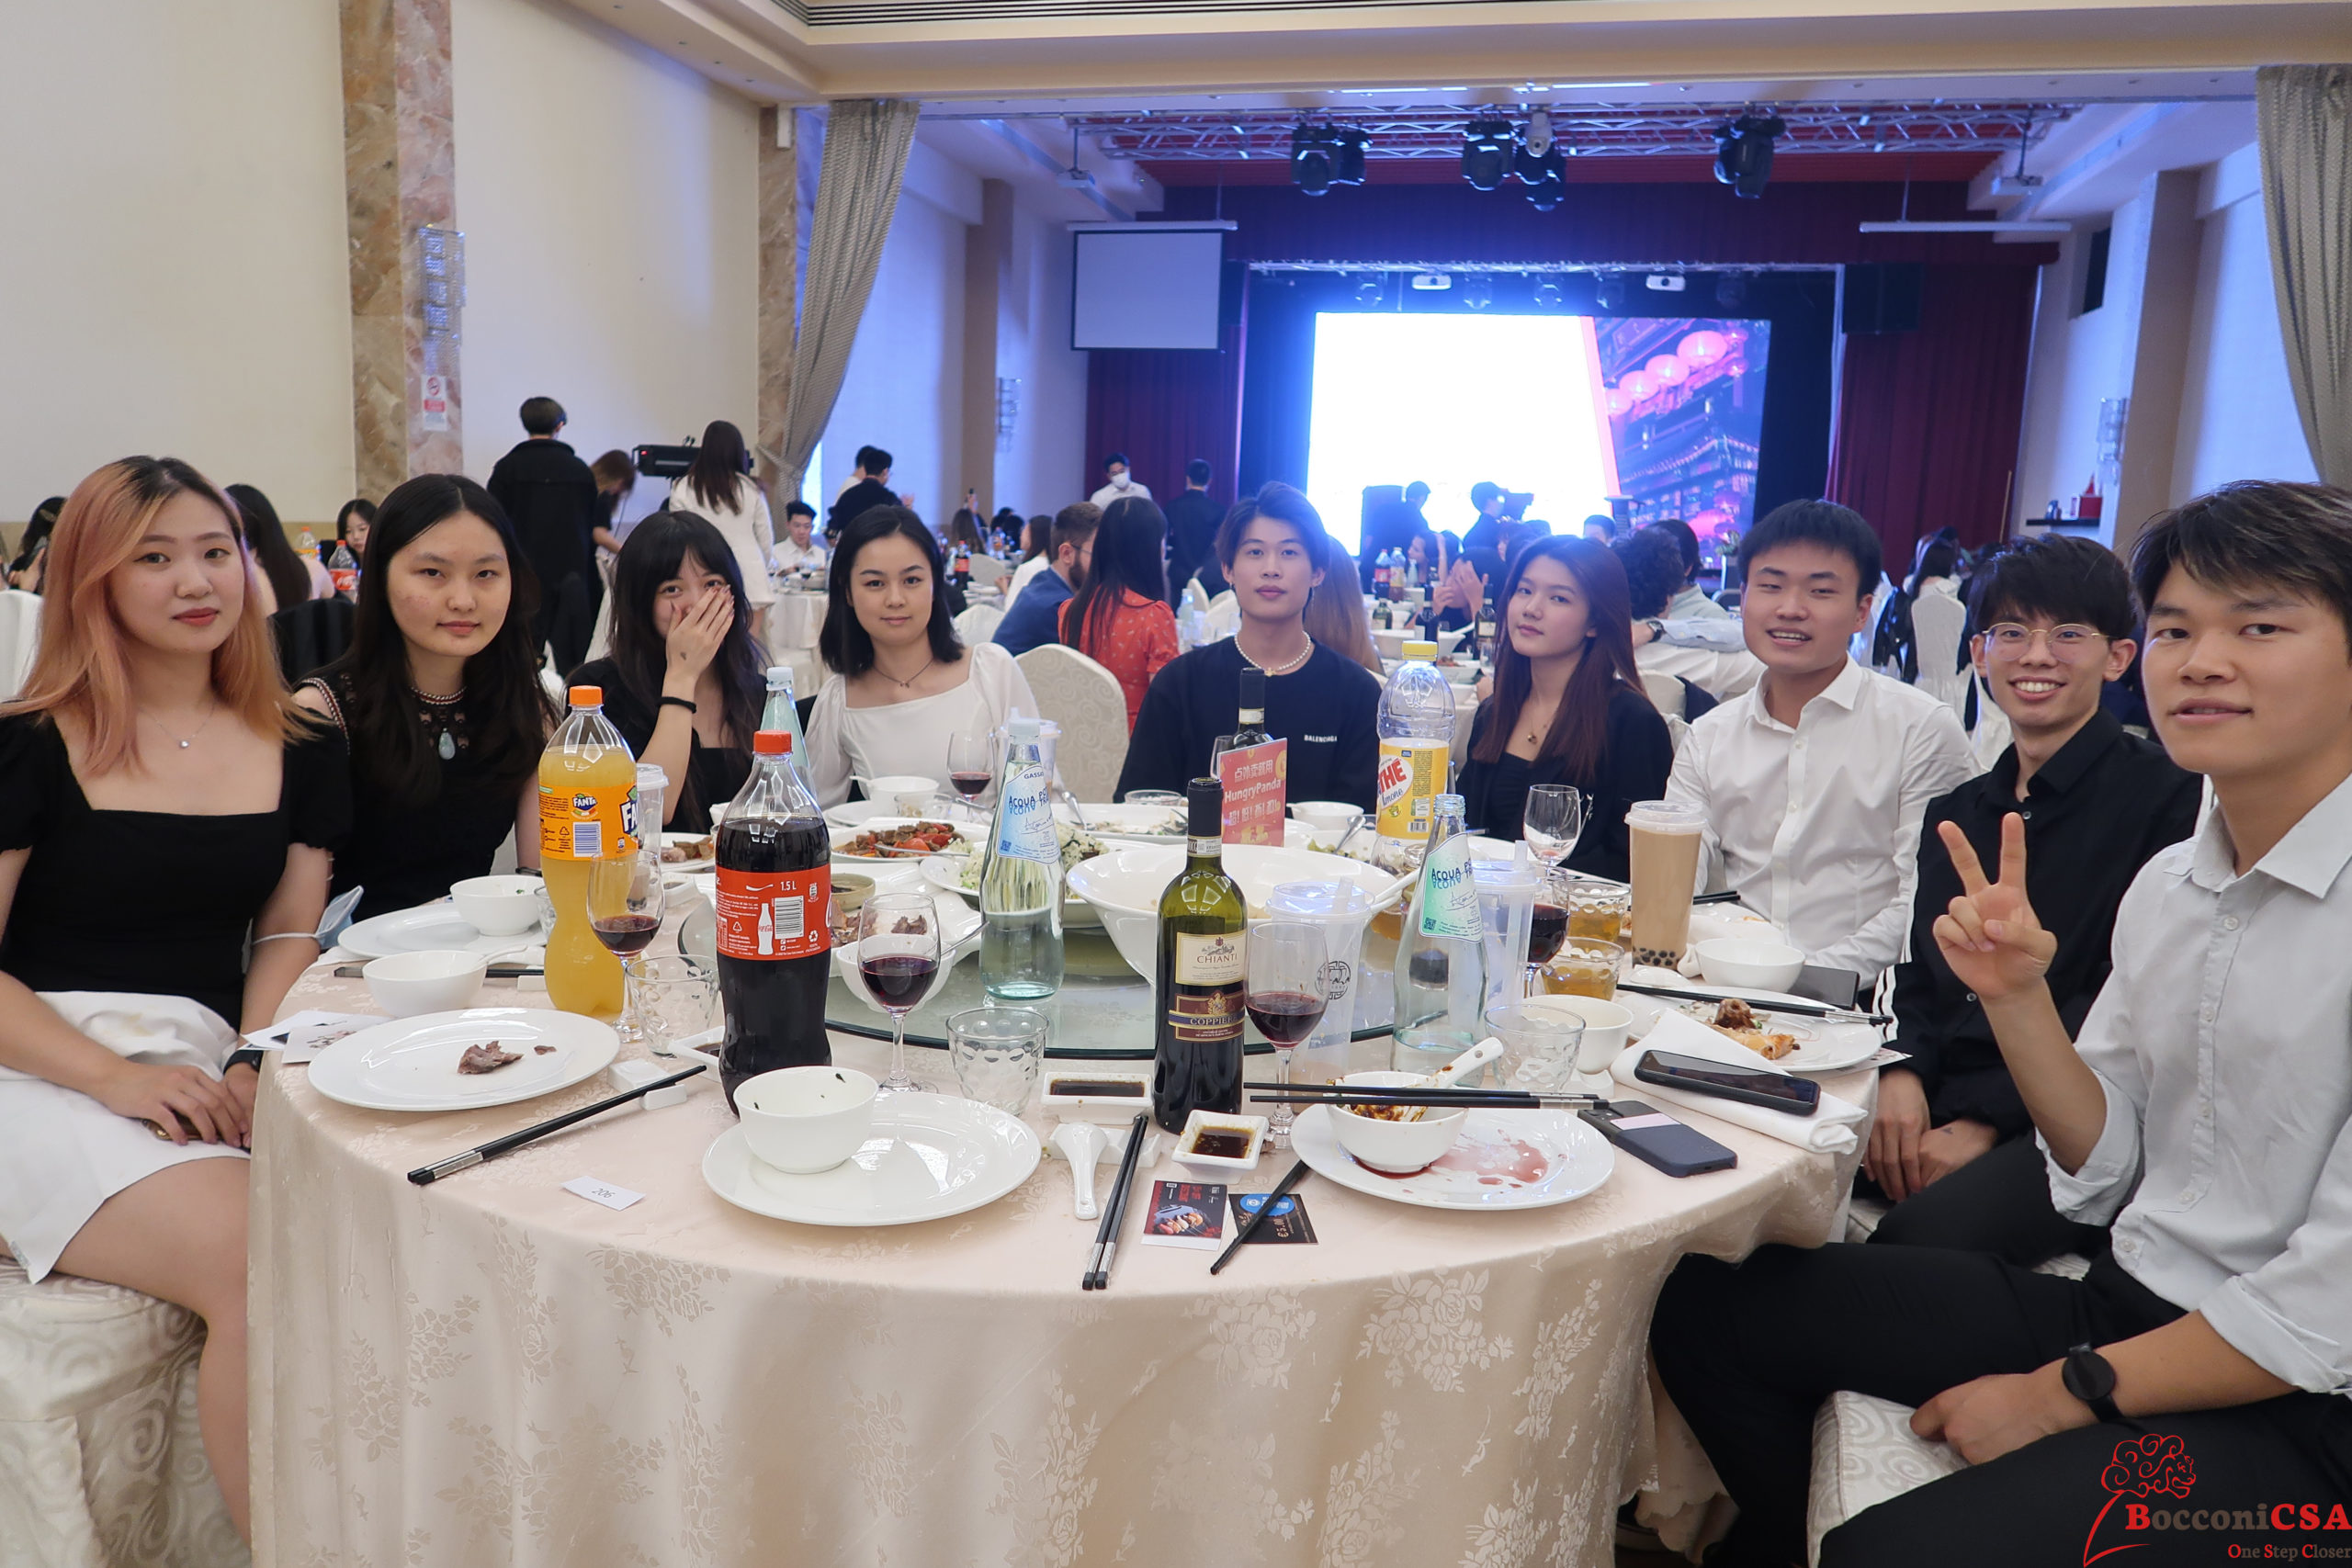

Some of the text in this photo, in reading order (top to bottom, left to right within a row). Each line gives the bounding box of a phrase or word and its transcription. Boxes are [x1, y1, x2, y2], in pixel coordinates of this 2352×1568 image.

[1225, 778, 1282, 804] HungryPanda
[572, 796, 598, 807] FANTA
[1009, 795, 1035, 807] ACQUA
[1431, 867, 1462, 881] ACQUA
[780, 881, 790, 891] 1.5
[1196, 953, 1238, 964] CHIANTI
